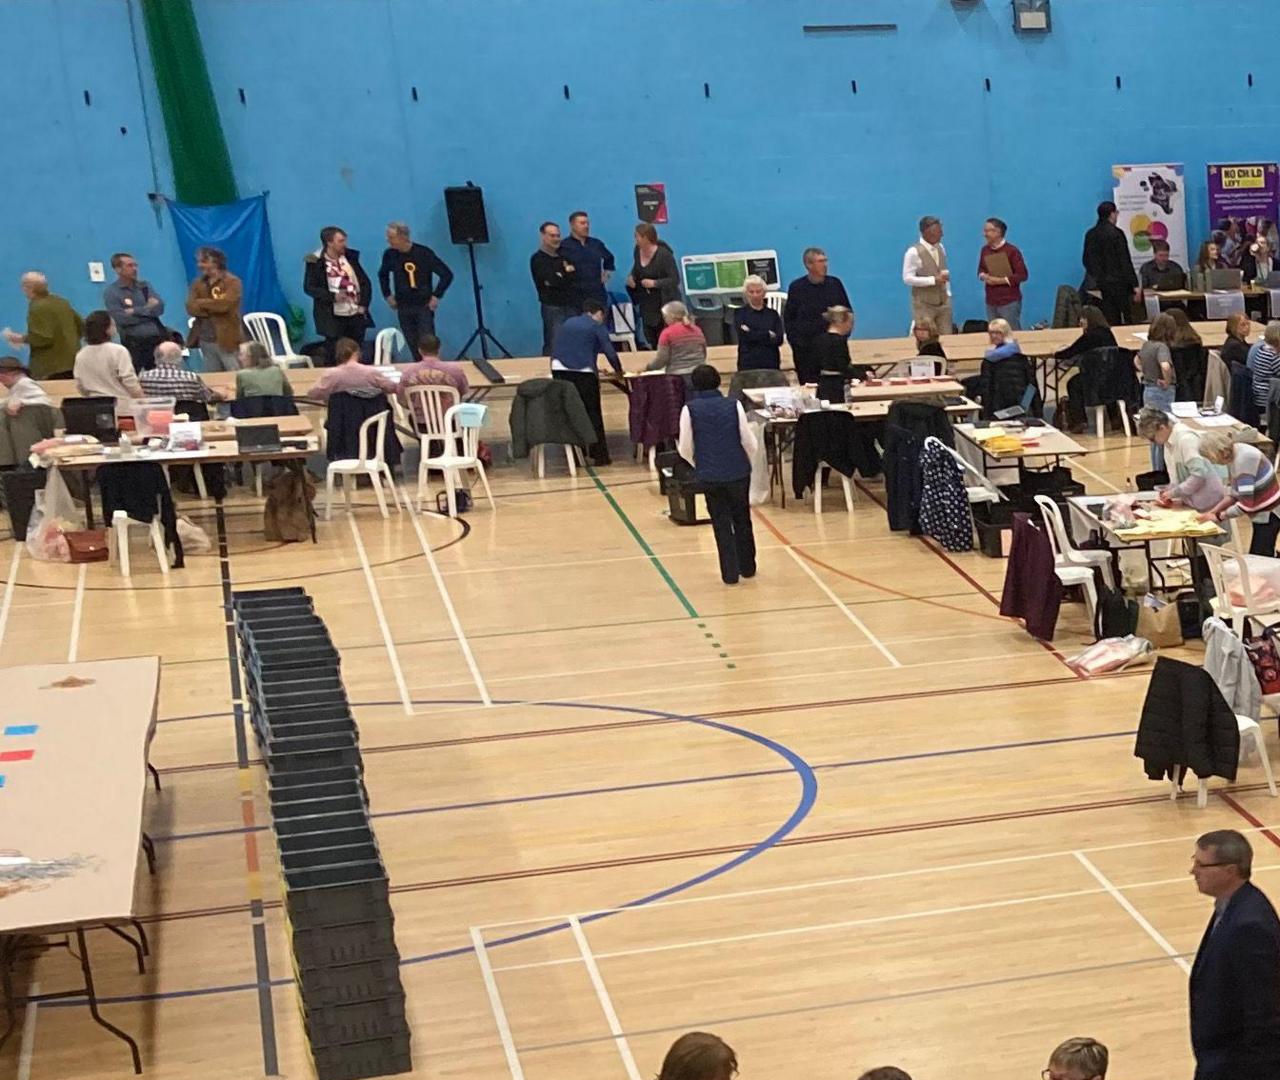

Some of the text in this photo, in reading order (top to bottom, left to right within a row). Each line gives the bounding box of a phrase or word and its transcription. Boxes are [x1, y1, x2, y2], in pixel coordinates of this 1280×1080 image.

[1223, 168, 1263, 178] NO CHLD
[1224, 179, 1240, 188] LEFT
